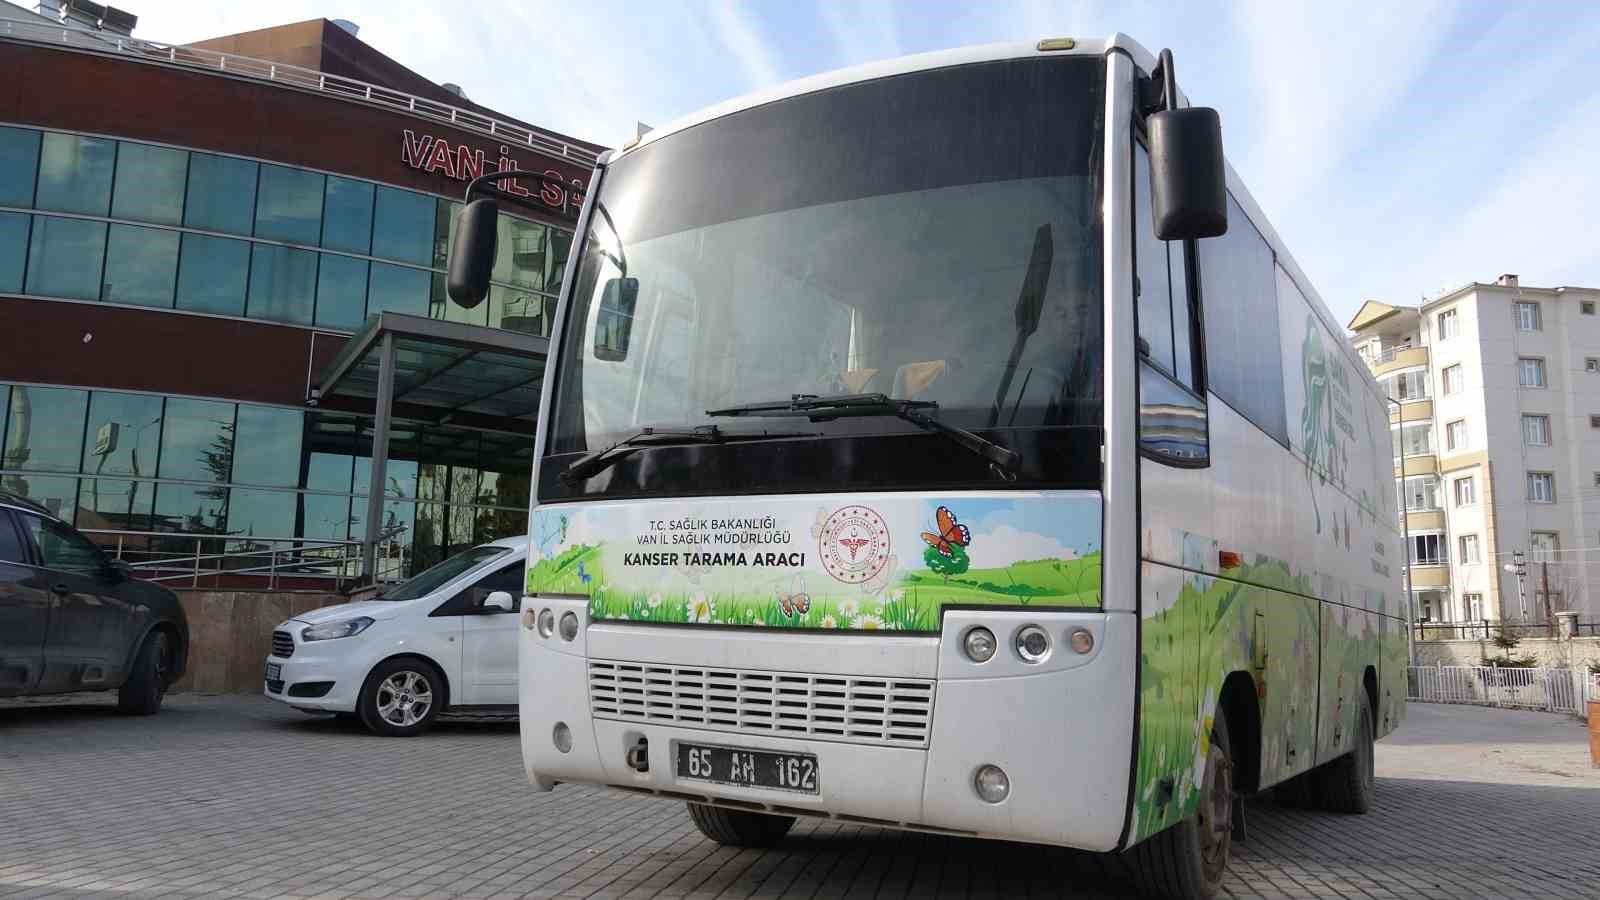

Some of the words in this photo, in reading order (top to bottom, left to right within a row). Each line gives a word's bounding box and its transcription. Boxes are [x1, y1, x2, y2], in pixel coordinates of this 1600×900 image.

[402, 131, 485, 180] VAN
[496, 144, 529, 197] İL
[669, 518, 708, 531] SAĞLIK
[711, 515, 776, 530] BAKANLIĞI
[637, 535, 658, 545] VAN
[660, 533, 670, 545] İL
[671, 532, 710, 545] SAĞLIK
[714, 530, 791, 545] MÜDÜRLÜĞÜ
[624, 552, 679, 566] KANSER
[684, 552, 748, 567] TARAMA
[752, 552, 805, 567] ARACI
[688, 748, 713, 776] 65
[775, 757, 815, 788] 162
